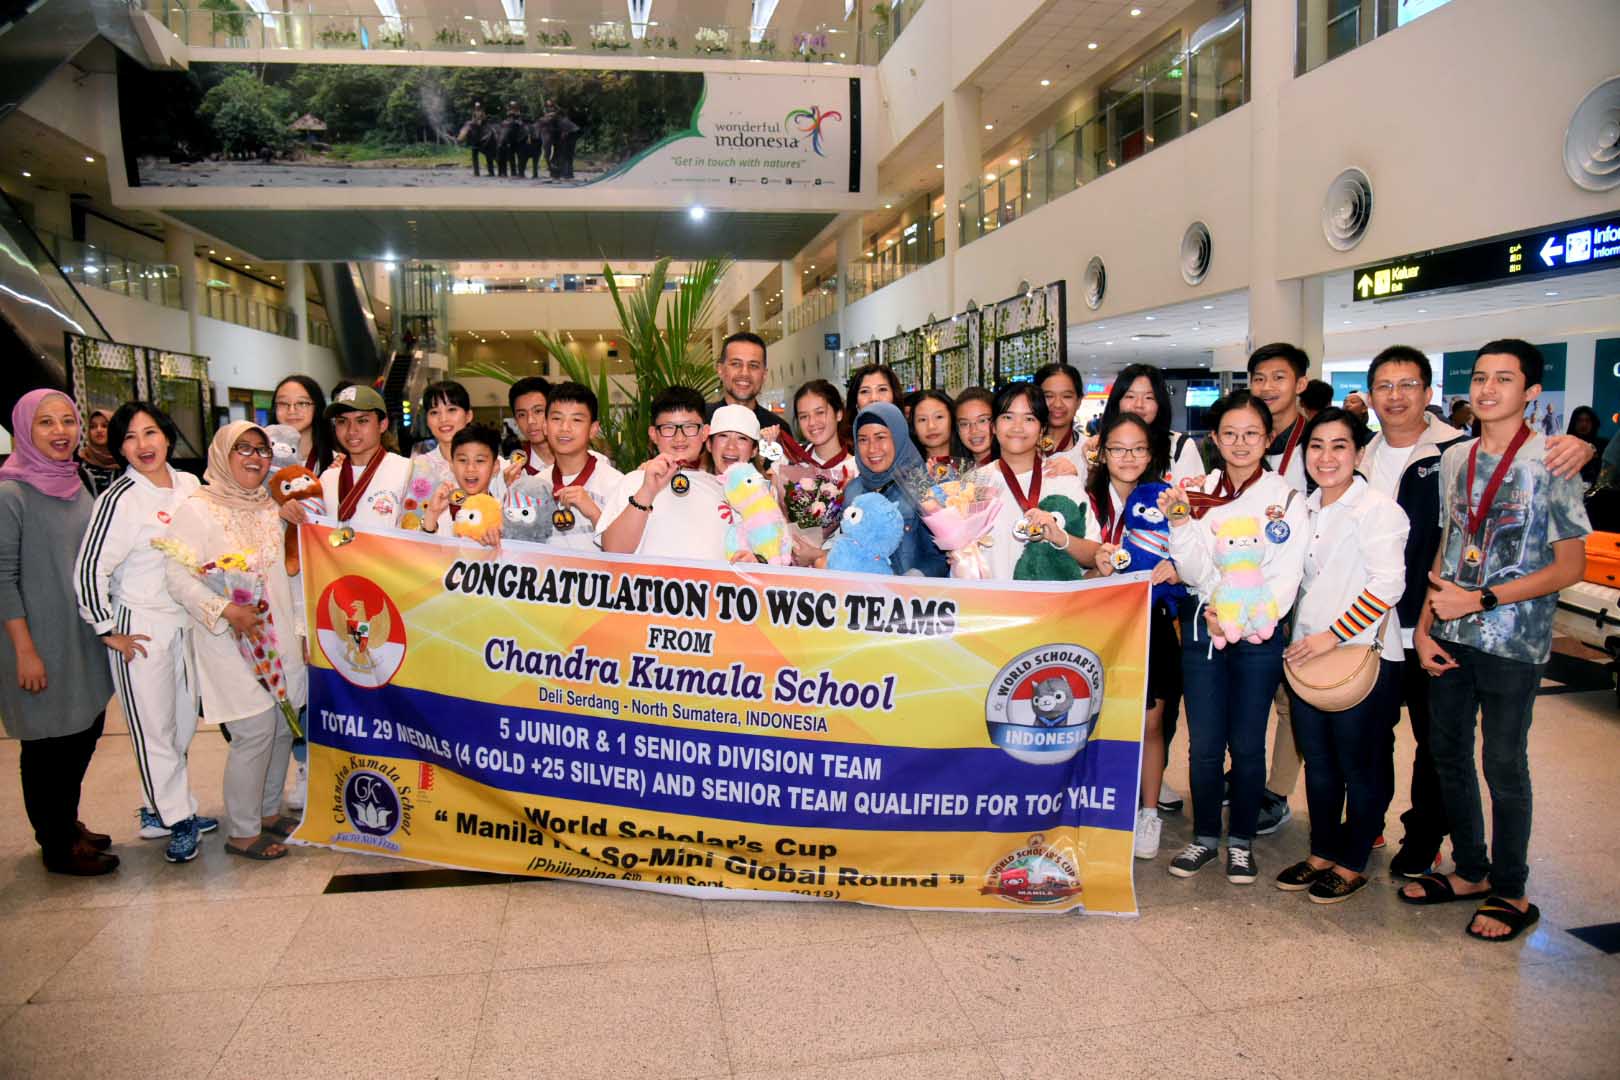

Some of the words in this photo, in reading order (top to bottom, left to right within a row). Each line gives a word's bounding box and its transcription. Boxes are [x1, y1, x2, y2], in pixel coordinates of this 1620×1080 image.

[715, 121, 780, 135] wonderful
[715, 133, 800, 149] indonesia
[695, 157, 705, 167] in
[707, 157, 736, 168] touch
[739, 158, 760, 168] with
[445, 561, 708, 618] CONGRATULATION
[716, 583, 758, 622] TO
[765, 589, 837, 628] WSC
[845, 594, 956, 636] TEAMS
[648, 627, 712, 654] FROM
[485, 638, 619, 685] Chandra
[628, 654, 763, 699] Kumala
[775, 668, 895, 710] School
[997, 660, 1032, 698] WORLD
[1034, 651, 1096, 674] SCHOLAR'S
[539, 687, 563, 702] Deli
[567, 690, 620, 714] Serdang
[632, 699, 668, 718] North
[672, 704, 741, 726] Sumatera,
[746, 711, 828, 732] INDONESIA
[320, 709, 368, 738] TOTAL
[372, 718, 393, 740] 29
[455, 742, 471, 768] (4
[475, 746, 525, 775] GOLD
[531, 756, 565, 781] +25
[571, 760, 646, 798] SILVER)
[652, 773, 696, 798] AND
[702, 778, 781, 808] SENIOR
[788, 786, 847, 812] TEAM
[854, 792, 969, 816] QUALIFIED
[976, 794, 1018, 816] FOR
[1067, 787, 1116, 811] YALE
[500, 718, 510, 739] 5
[516, 720, 590, 750] JUNIOR
[595, 731, 610, 752] &
[616, 732, 626, 754] 1
[634, 735, 711, 763] SENIOR
[718, 744, 814, 775] DIVISION
[821, 754, 881, 780] TEAM
[332, 765, 350, 825] Chandra
[349, 756, 401, 784] Kumala
[399, 786, 416, 837] School
[456, 812, 544, 847] Manila
[724, 855, 826, 886] Global
[838, 867, 939, 888] Round
[523, 807, 608, 837] World
[775, 837, 838, 860] Cup
[1061, 861, 1076, 878] CUP
